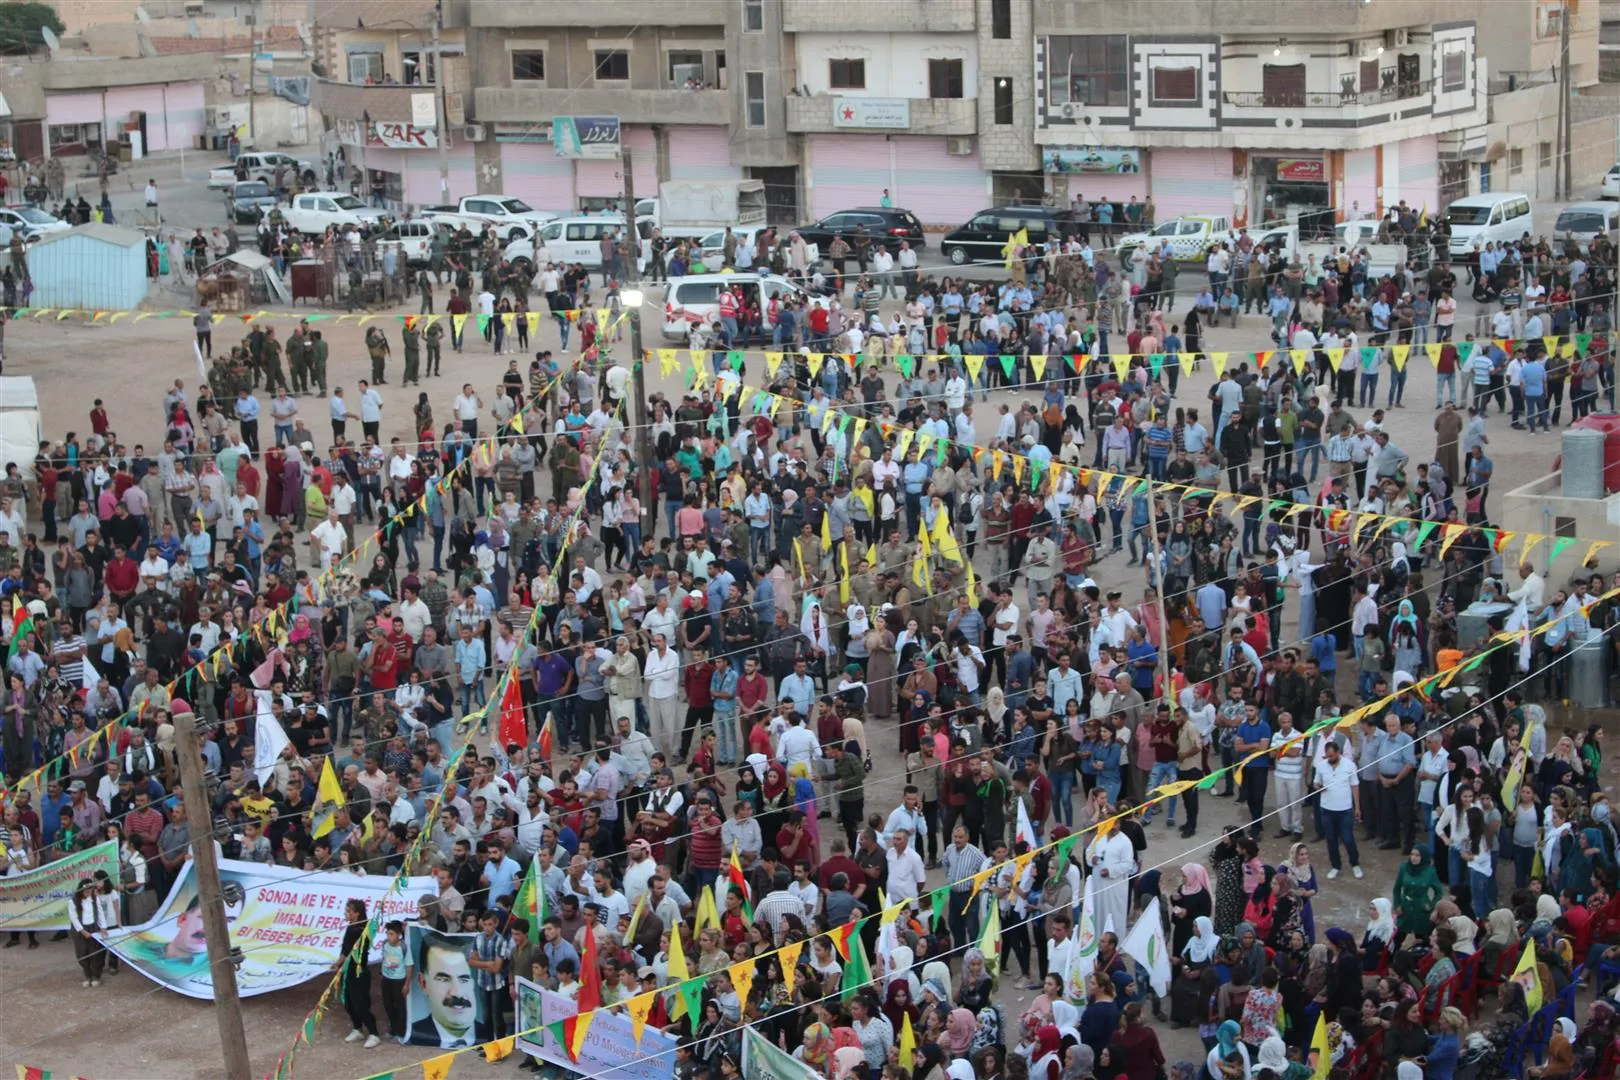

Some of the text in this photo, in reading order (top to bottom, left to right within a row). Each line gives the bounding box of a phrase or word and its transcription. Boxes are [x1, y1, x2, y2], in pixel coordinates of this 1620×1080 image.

[257, 887, 298, 906] SONDA
[319, 895, 336, 909] YE
[237, 926, 252, 937] BI
[294, 934, 320, 947] APO
